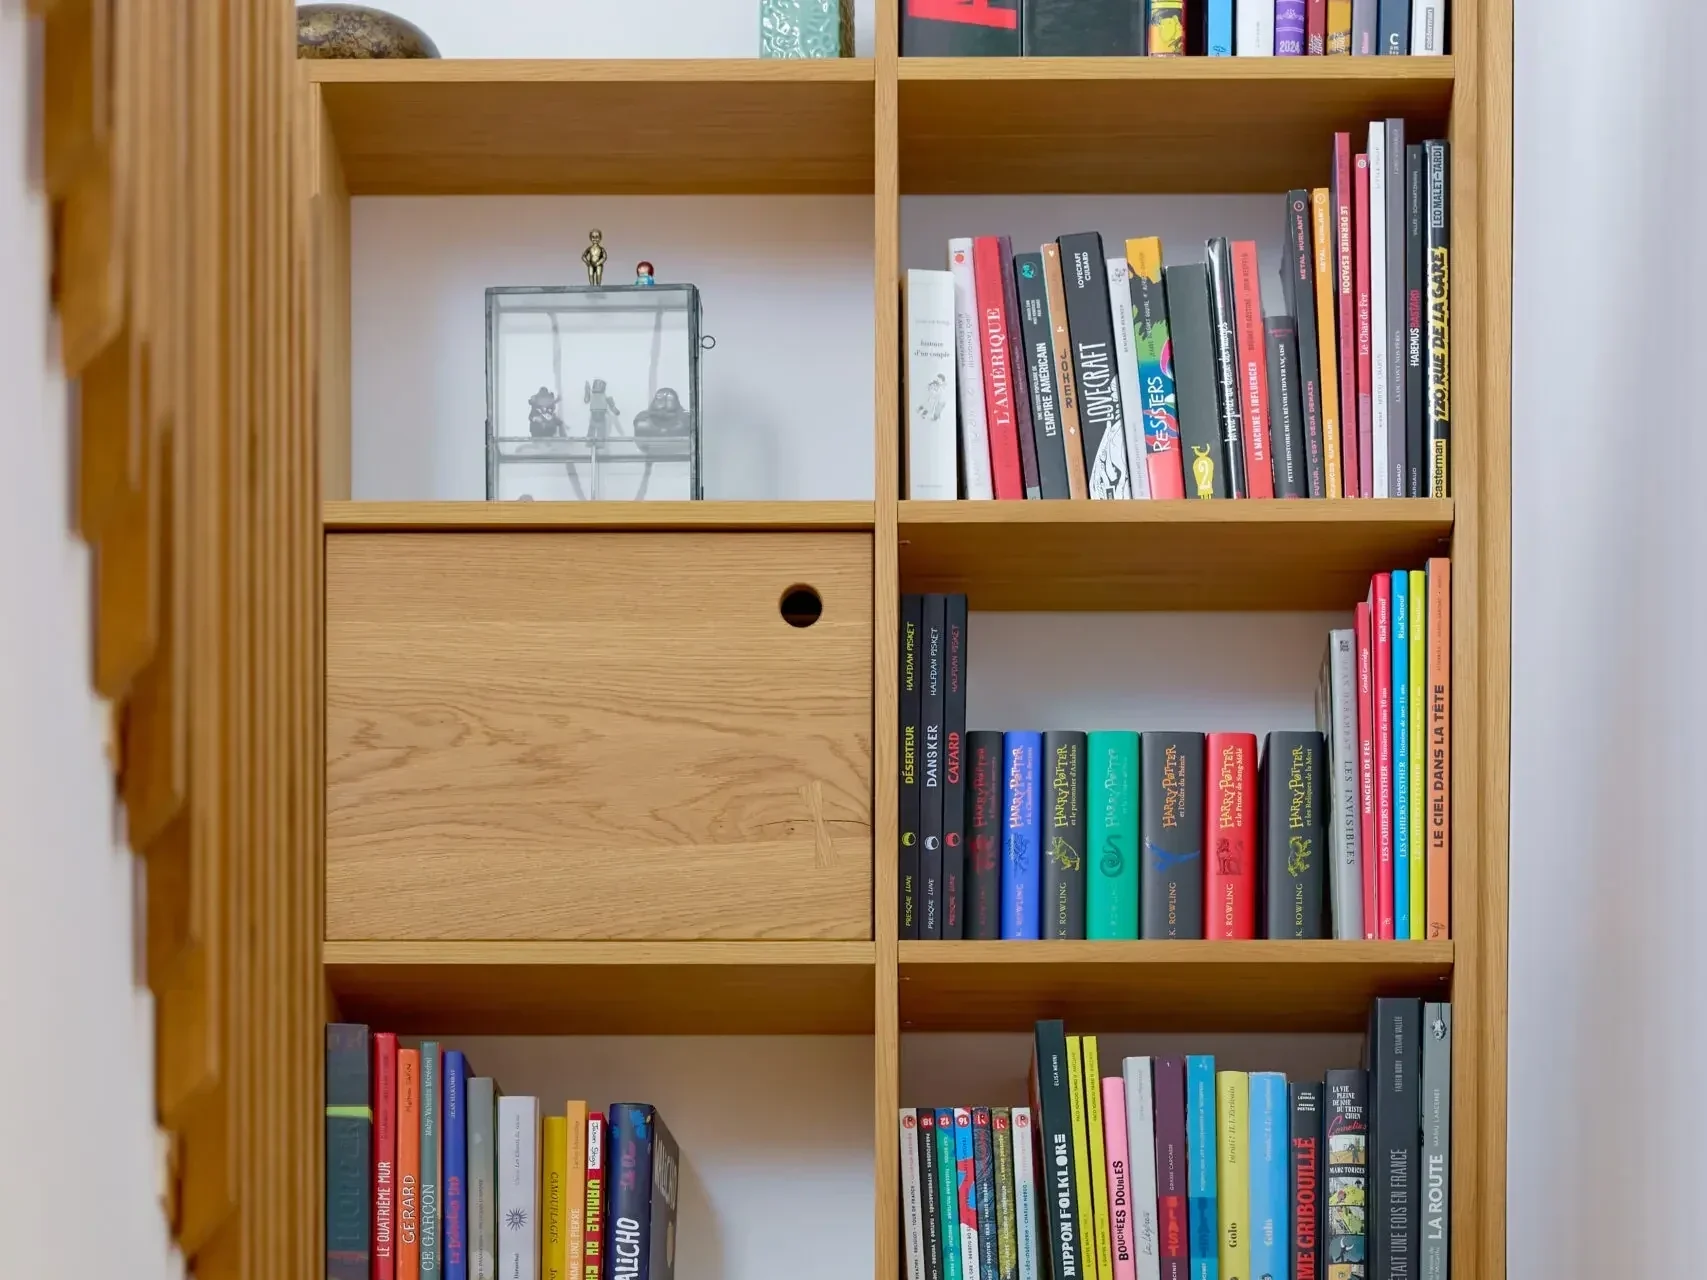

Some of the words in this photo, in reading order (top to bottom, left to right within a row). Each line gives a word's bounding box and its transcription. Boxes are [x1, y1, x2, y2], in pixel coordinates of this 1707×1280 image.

[1279, 40, 1300, 53] 2024
[1340, 206, 1349, 215] LE
[1433, 210, 1442, 226] LEO
[1341, 216, 1349, 253] DERNIER
[1074, 252, 1085, 288] LOVECRAFT
[1082, 251, 1091, 281] CULBARD
[1342, 255, 1350, 294] ESPADON
[1430, 251, 1446, 299] GARE
[1359, 321, 1369, 343] Char
[1410, 327, 1420, 367] HABEMUS
[1433, 324, 1445, 350] DE
[986, 307, 1011, 425] L'AMÉRIQUE
[1278, 343, 1288, 377] FRANÇAISE
[1359, 344, 1369, 356] Le
[1036, 342, 1052, 393] AMÉRICAIN
[1079, 342, 1115, 423] LOVECRAFT
[1248, 361, 1261, 406] INFLUENCER
[1432, 351, 1446, 386] RUE
[1280, 377, 1290, 415] RÉVOLUTION
[1307, 380, 1315, 413] DEMAIN
[1432, 387, 1448, 417] 120,
[1042, 394, 1057, 437] L'EMPIRE
[1251, 415, 1263, 450] MACHINE
[1283, 432, 1293, 462] HISTOIRE
[1254, 450, 1264, 461] LA
[1434, 440, 1444, 498] casterman
[1285, 462, 1294, 483] PETITE
[1379, 597, 1387, 625] Sattouf
[1397, 594, 1405, 621] Sattouf
[906, 621, 915, 651] PISKET
[930, 627, 939, 656] PISKET
[951, 624, 960, 653] PISKET
[1379, 625, 1387, 643] Riad
[1397, 622, 1405, 639] Riad
[906, 654, 914, 691] HALFDAN
[929, 659, 938, 696] HALFDAN
[951, 655, 959, 693] HALFDAN
[1431, 684, 1445, 722] TÊTE
[1363, 740, 1371, 756] FEU
[1434, 726, 1445, 745] LA
[901, 725, 915, 784] DÉSERTEUR
[926, 725, 938, 787] DANSKER
[947, 732, 960, 784] CAFARD
[1009, 745, 1025, 790] POTTER
[1053, 744, 1069, 789] POTTER
[1162, 744, 1177, 789] POTTER
[1218, 745, 1234, 790] POTTER
[1288, 744, 1304, 790] POTTER
[1343, 760, 1353, 782] LES
[1433, 749, 1444, 791] DANS
[1380, 765, 1389, 807] D'ESTHER
[1398, 761, 1407, 803] D'ESTHER
[1009, 788, 1027, 829] HARRY
[1053, 788, 1071, 828] HARRY
[1162, 788, 1179, 828] HARRY
[1219, 788, 1236, 829] HARRY
[1288, 788, 1305, 829] HARRY
[1398, 804, 1407, 842] CAHIERS
[1433, 795, 1444, 827] CIEL
[1381, 808, 1389, 846] CAHIERS
[1433, 830, 1444, 848] LE
[1381, 846, 1389, 862] LES
[1398, 842, 1407, 857] LES
[904, 875, 912, 893] LUNE
[927, 877, 935, 896] LUNE
[904, 896, 913, 927] PRESQUE
[927, 899, 935, 929] PRESQUE
[1393, 1034, 1403, 1055] SYLVAIN
[1052, 1071, 1060, 1087] ELISA
[1340, 1085, 1350, 1093] VIE
[940, 1118, 950, 1126] 12
[958, 1117, 968, 1126] 16
[1432, 1088, 1441, 1123] LARCENET
[591, 1122, 599, 1144] Jason
[1432, 1125, 1440, 1147] MANU
[377, 1161, 391, 1183] MUR
[589, 1146, 599, 1167] Shiga
[1390, 1148, 1408, 1188] FRANCE
[1054, 1134, 1072, 1219] FOLKLORE
[1292, 1137, 1316, 1248] GRIBOUILLÉ
[1428, 1154, 1443, 1213] ROUTE
[1390, 1191, 1408, 1204] EN
[376, 1187, 392, 1242] QUATRIÈME
[421, 1183, 436, 1247] GARÇON
[1390, 1206, 1408, 1229] FOIS
[1428, 1216, 1443, 1239] LA
[376, 1246, 390, 1257] LE
[1060, 1222, 1076, 1277] NIPPON
[1115, 1210, 1129, 1261] BOUCHÉES
[1227, 1222, 1238, 1248] Golo
[1390, 1232, 1408, 1253] UNE
[421, 1251, 434, 1271] CE
